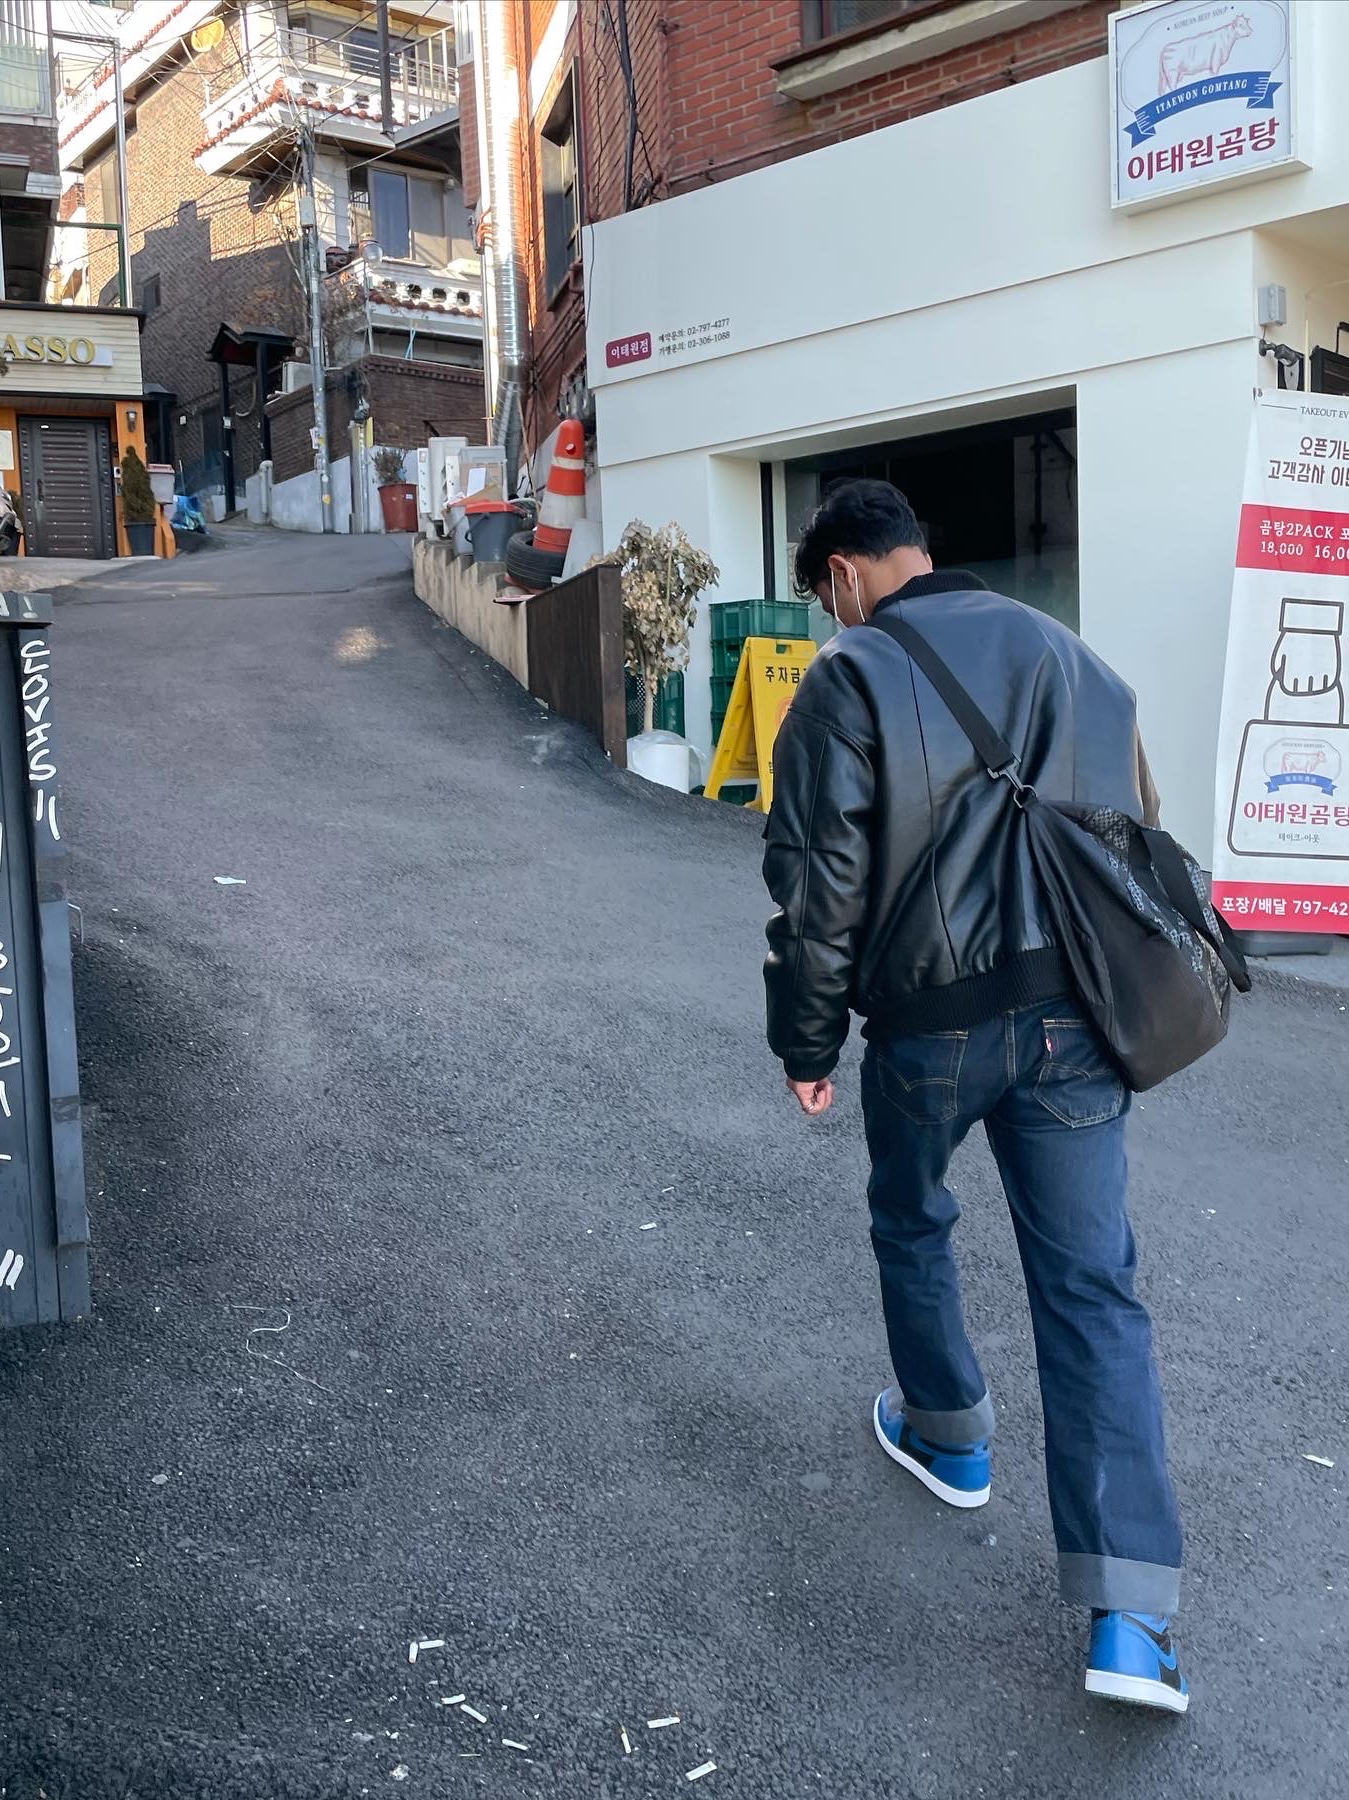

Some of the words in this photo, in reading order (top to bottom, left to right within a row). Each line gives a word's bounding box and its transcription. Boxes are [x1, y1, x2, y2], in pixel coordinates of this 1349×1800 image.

[1155, 87, 1199, 115] ITAEWON
[1201, 78, 1249, 96] GOMTANG
[1127, 117, 1281, 181] 이태원곰탕
[0, 333, 96, 365] ASSO
[611, 338, 649, 359] 이태원점
[1300, 406, 1338, 418] TAKEOUT
[1268, 459, 1325, 485] 고객감사
[1260, 520, 1334, 539] 곰탕2PACK
[1260, 541, 1304, 557] 18,000
[1243, 802, 1349, 827] 이태원곰탕
[1221, 897, 1288, 916] 포장/배달
[1292, 900, 1349, 917] 797-42
